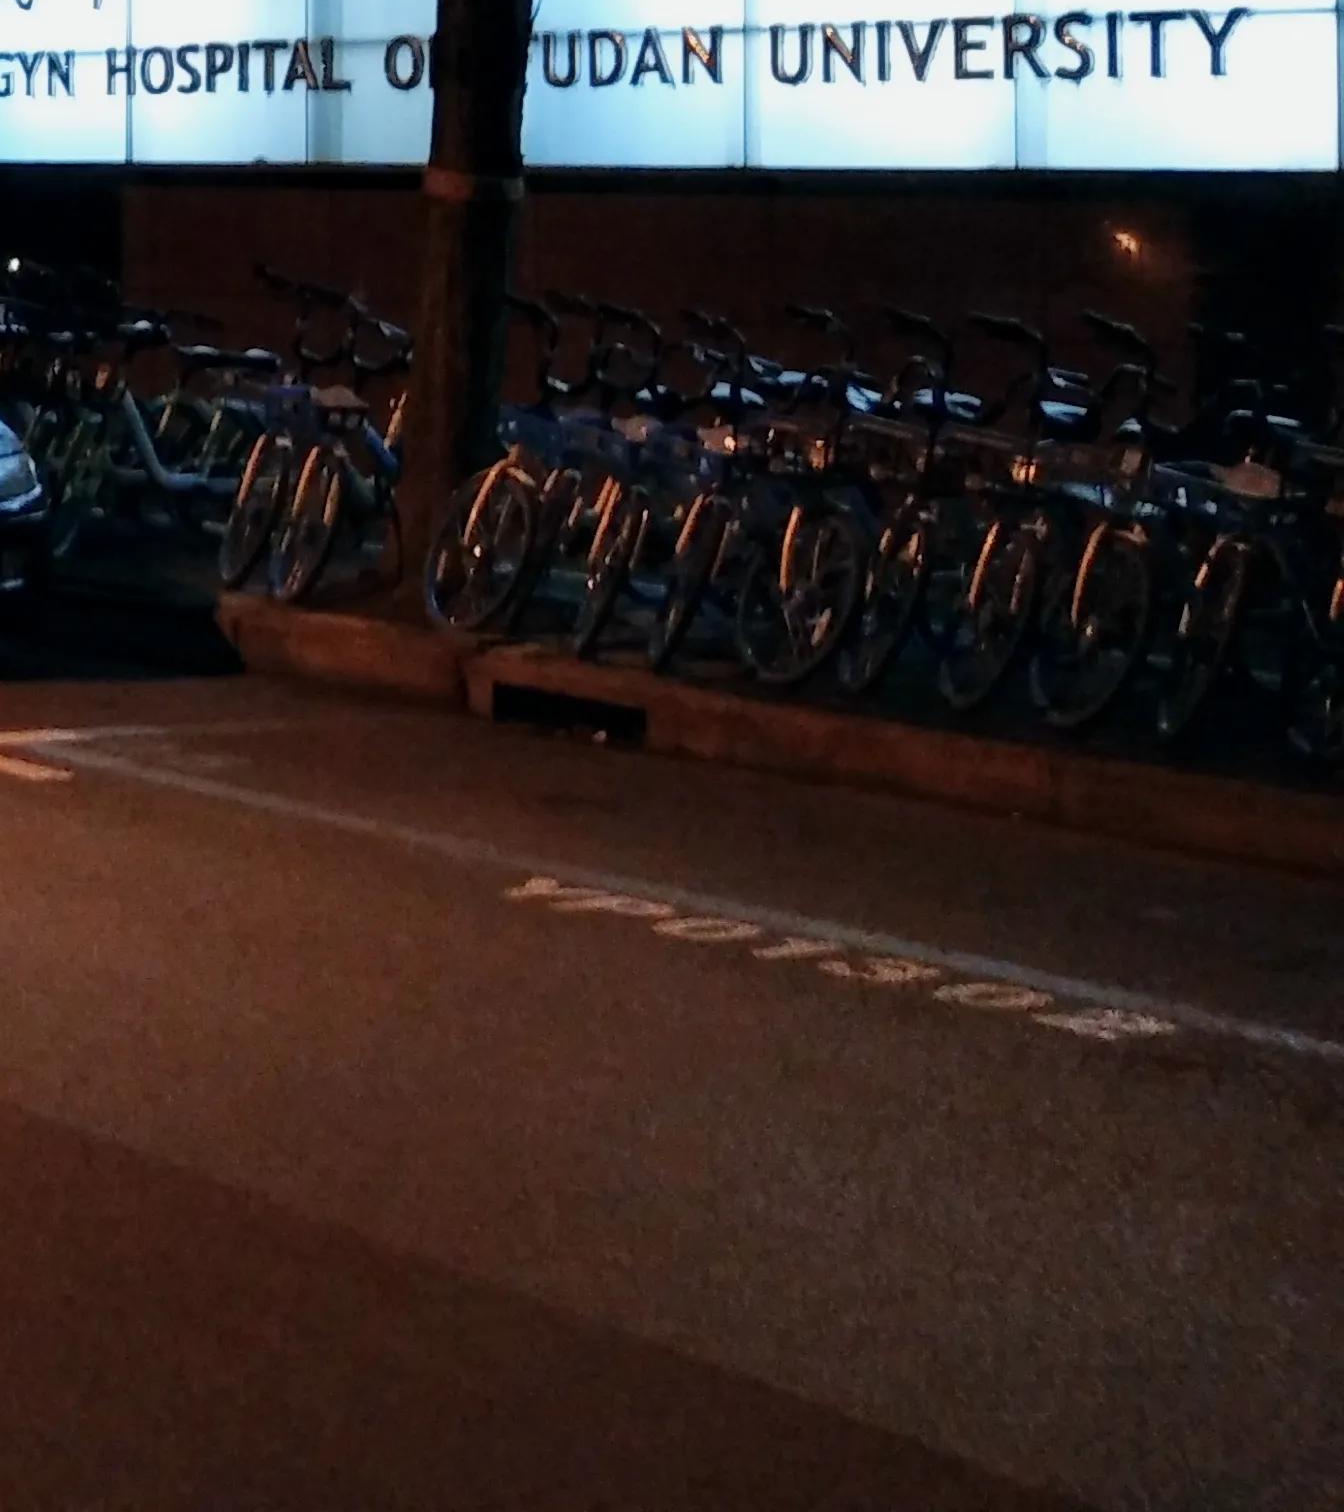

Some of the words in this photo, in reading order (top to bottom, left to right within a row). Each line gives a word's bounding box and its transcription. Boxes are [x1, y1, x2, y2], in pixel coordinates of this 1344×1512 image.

[105, 35, 352, 95] HOSPITAL
[384, 33, 436, 91] O
[528, 25, 724, 90] UDAN
[768, 7, 1253, 86] UNIVERSITY
